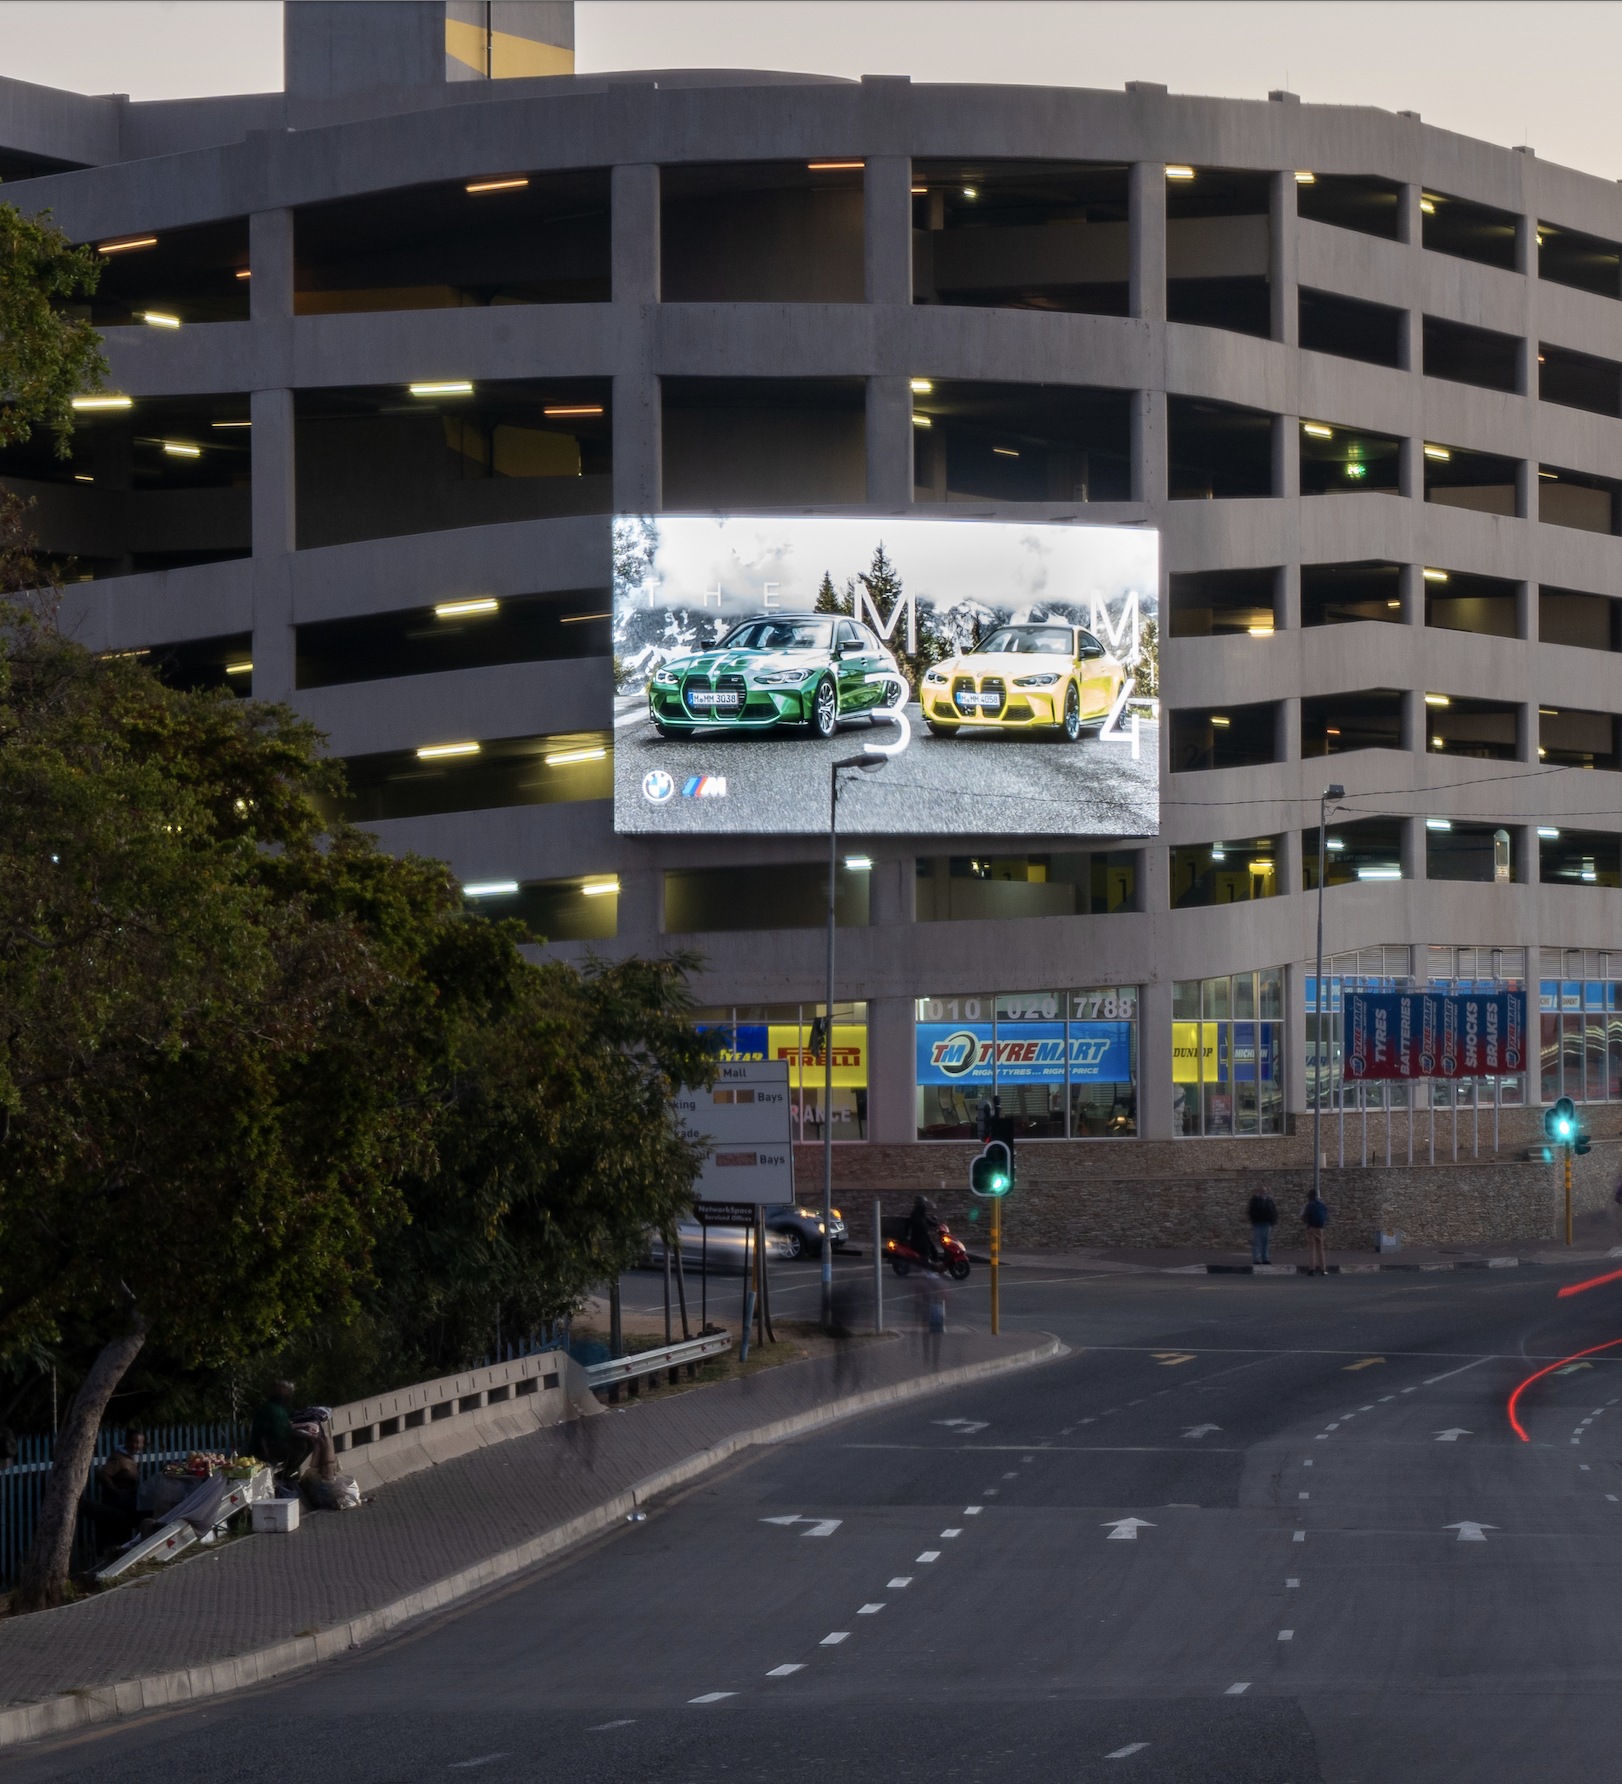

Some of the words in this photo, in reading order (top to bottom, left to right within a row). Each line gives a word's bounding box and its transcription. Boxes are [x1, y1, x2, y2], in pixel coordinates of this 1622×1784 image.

[927, 999, 981, 1020] 010
[1007, 998, 1057, 1019] 020
[1074, 997, 1132, 1019] 7788
[1354, 996, 1363, 1055] TYREMART
[1375, 1008, 1387, 1062] TYRES
[1423, 996, 1433, 1054] TYREMART
[1444, 998, 1454, 1055] TYREMART
[1466, 1002, 1478, 1068] SHOCKS
[1486, 1002, 1498, 1067] BRAKES
[1507, 994, 1517, 1049] TYREMART
[778, 1047, 861, 1066] PIRELLI
[979, 1042, 1108, 1062] TYREMART
[1400, 997, 1411, 1075] BATTERIES
[723, 1068, 747, 1078] Mall
[758, 1092, 783, 1103] Bays
[760, 1155, 785, 1166] Bays
